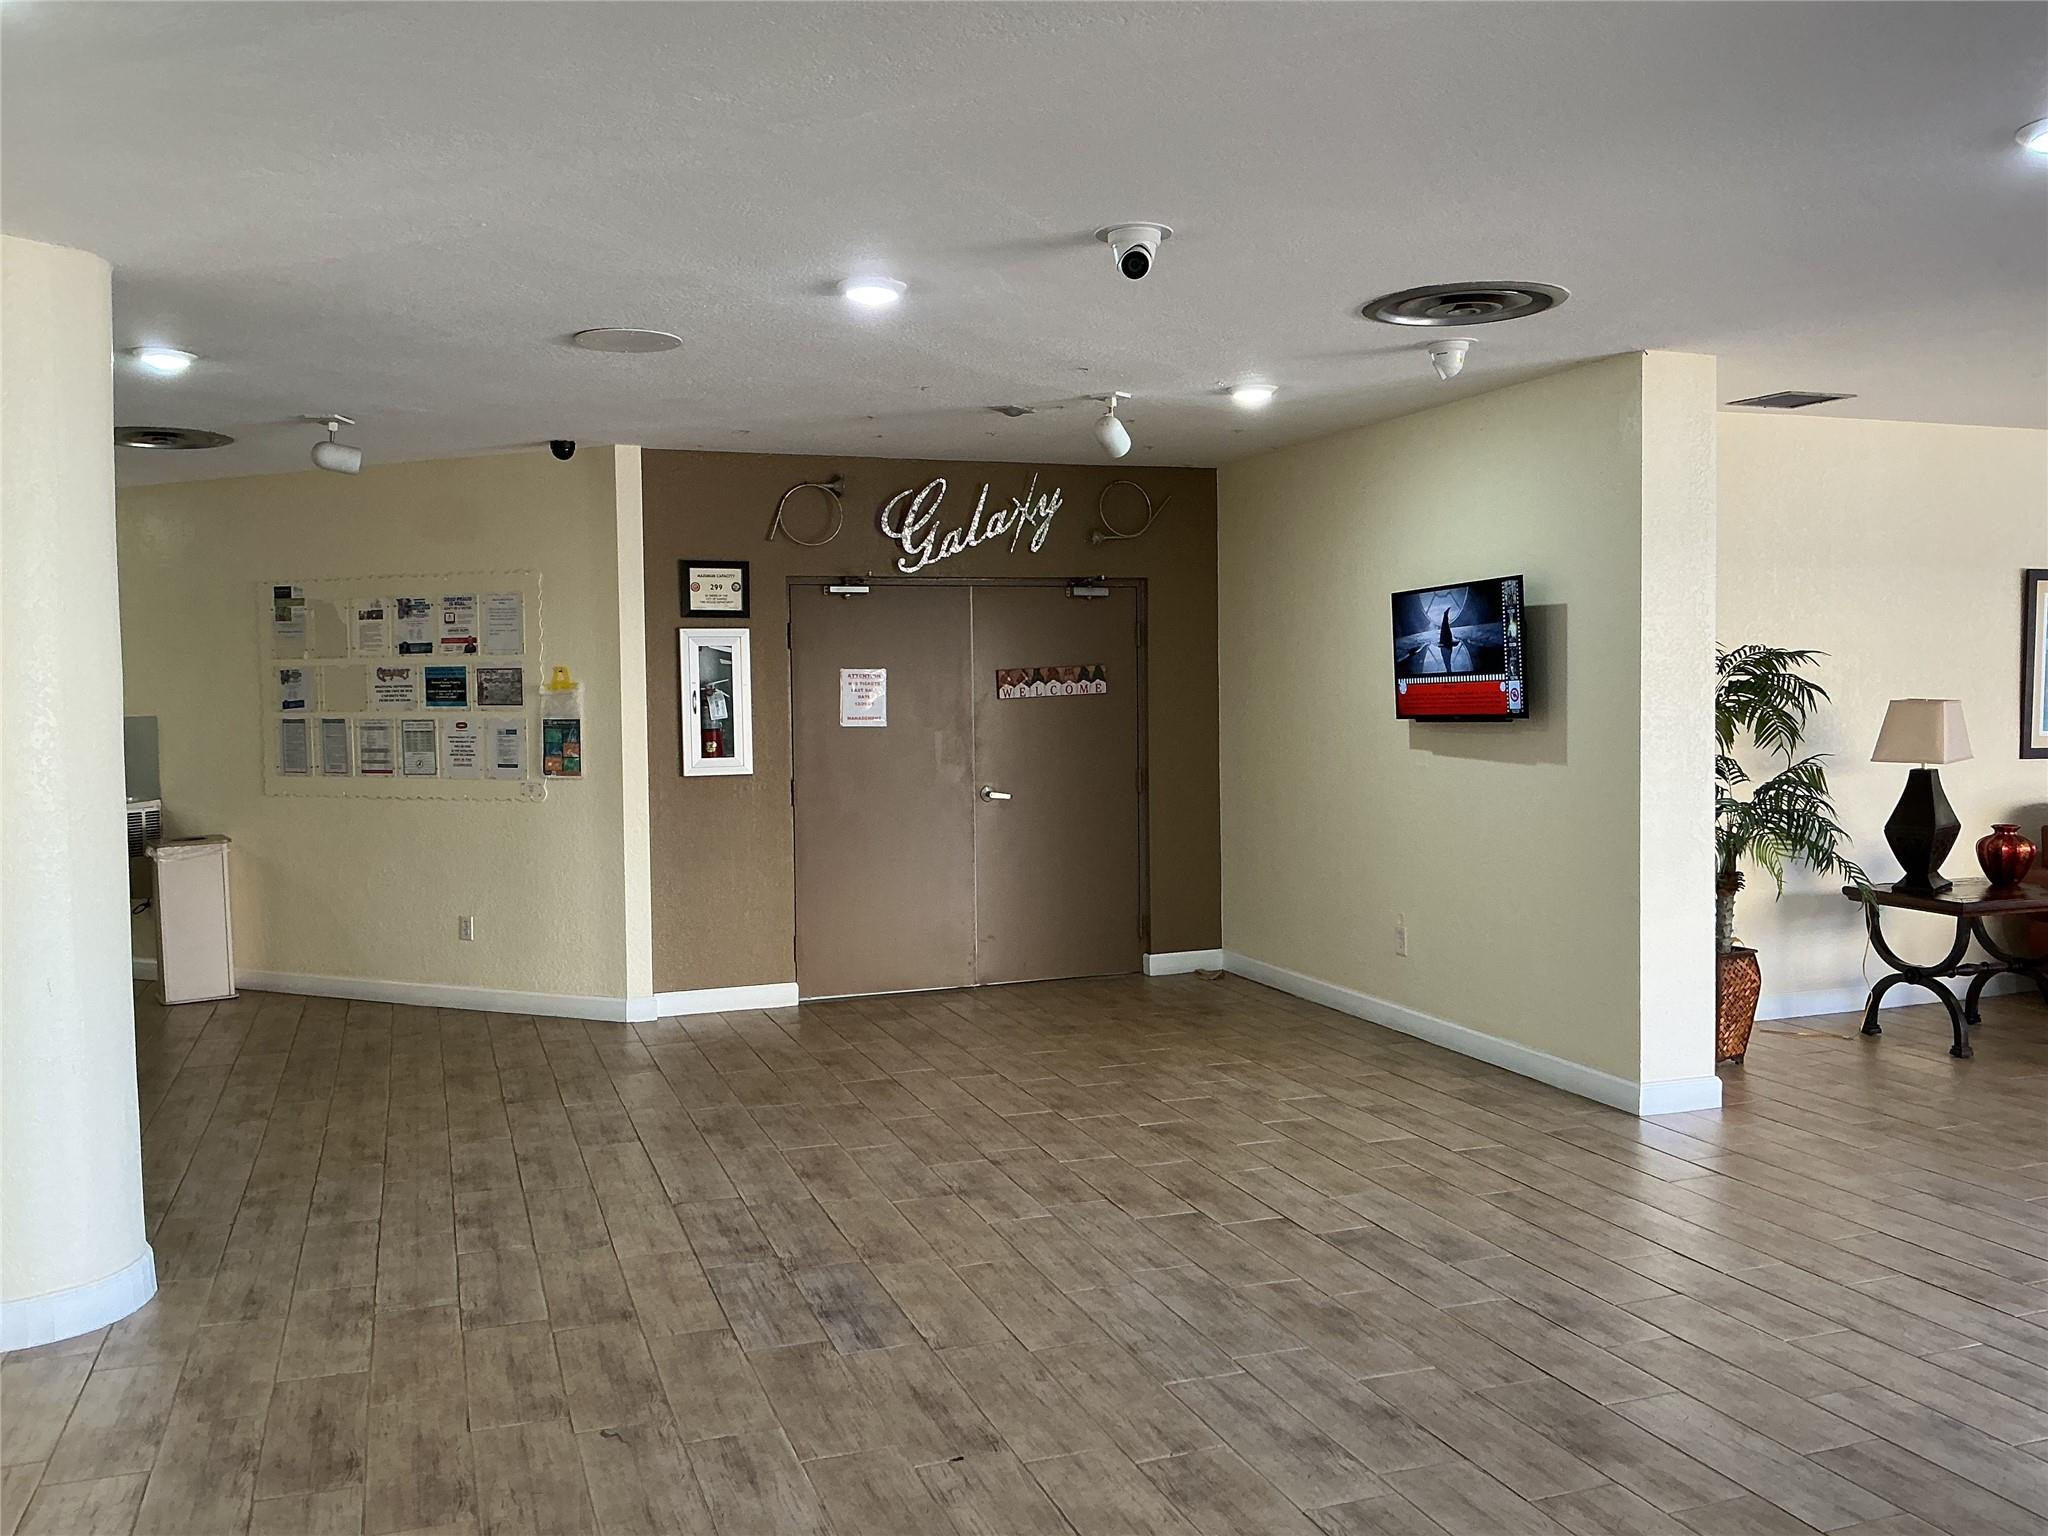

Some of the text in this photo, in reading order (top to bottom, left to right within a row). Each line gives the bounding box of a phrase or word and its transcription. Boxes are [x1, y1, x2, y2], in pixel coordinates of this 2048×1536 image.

[881, 472, 1063, 573] Galaxy
[710, 583, 723, 591] 299
[1002, 683, 1103, 699] WELCOME
